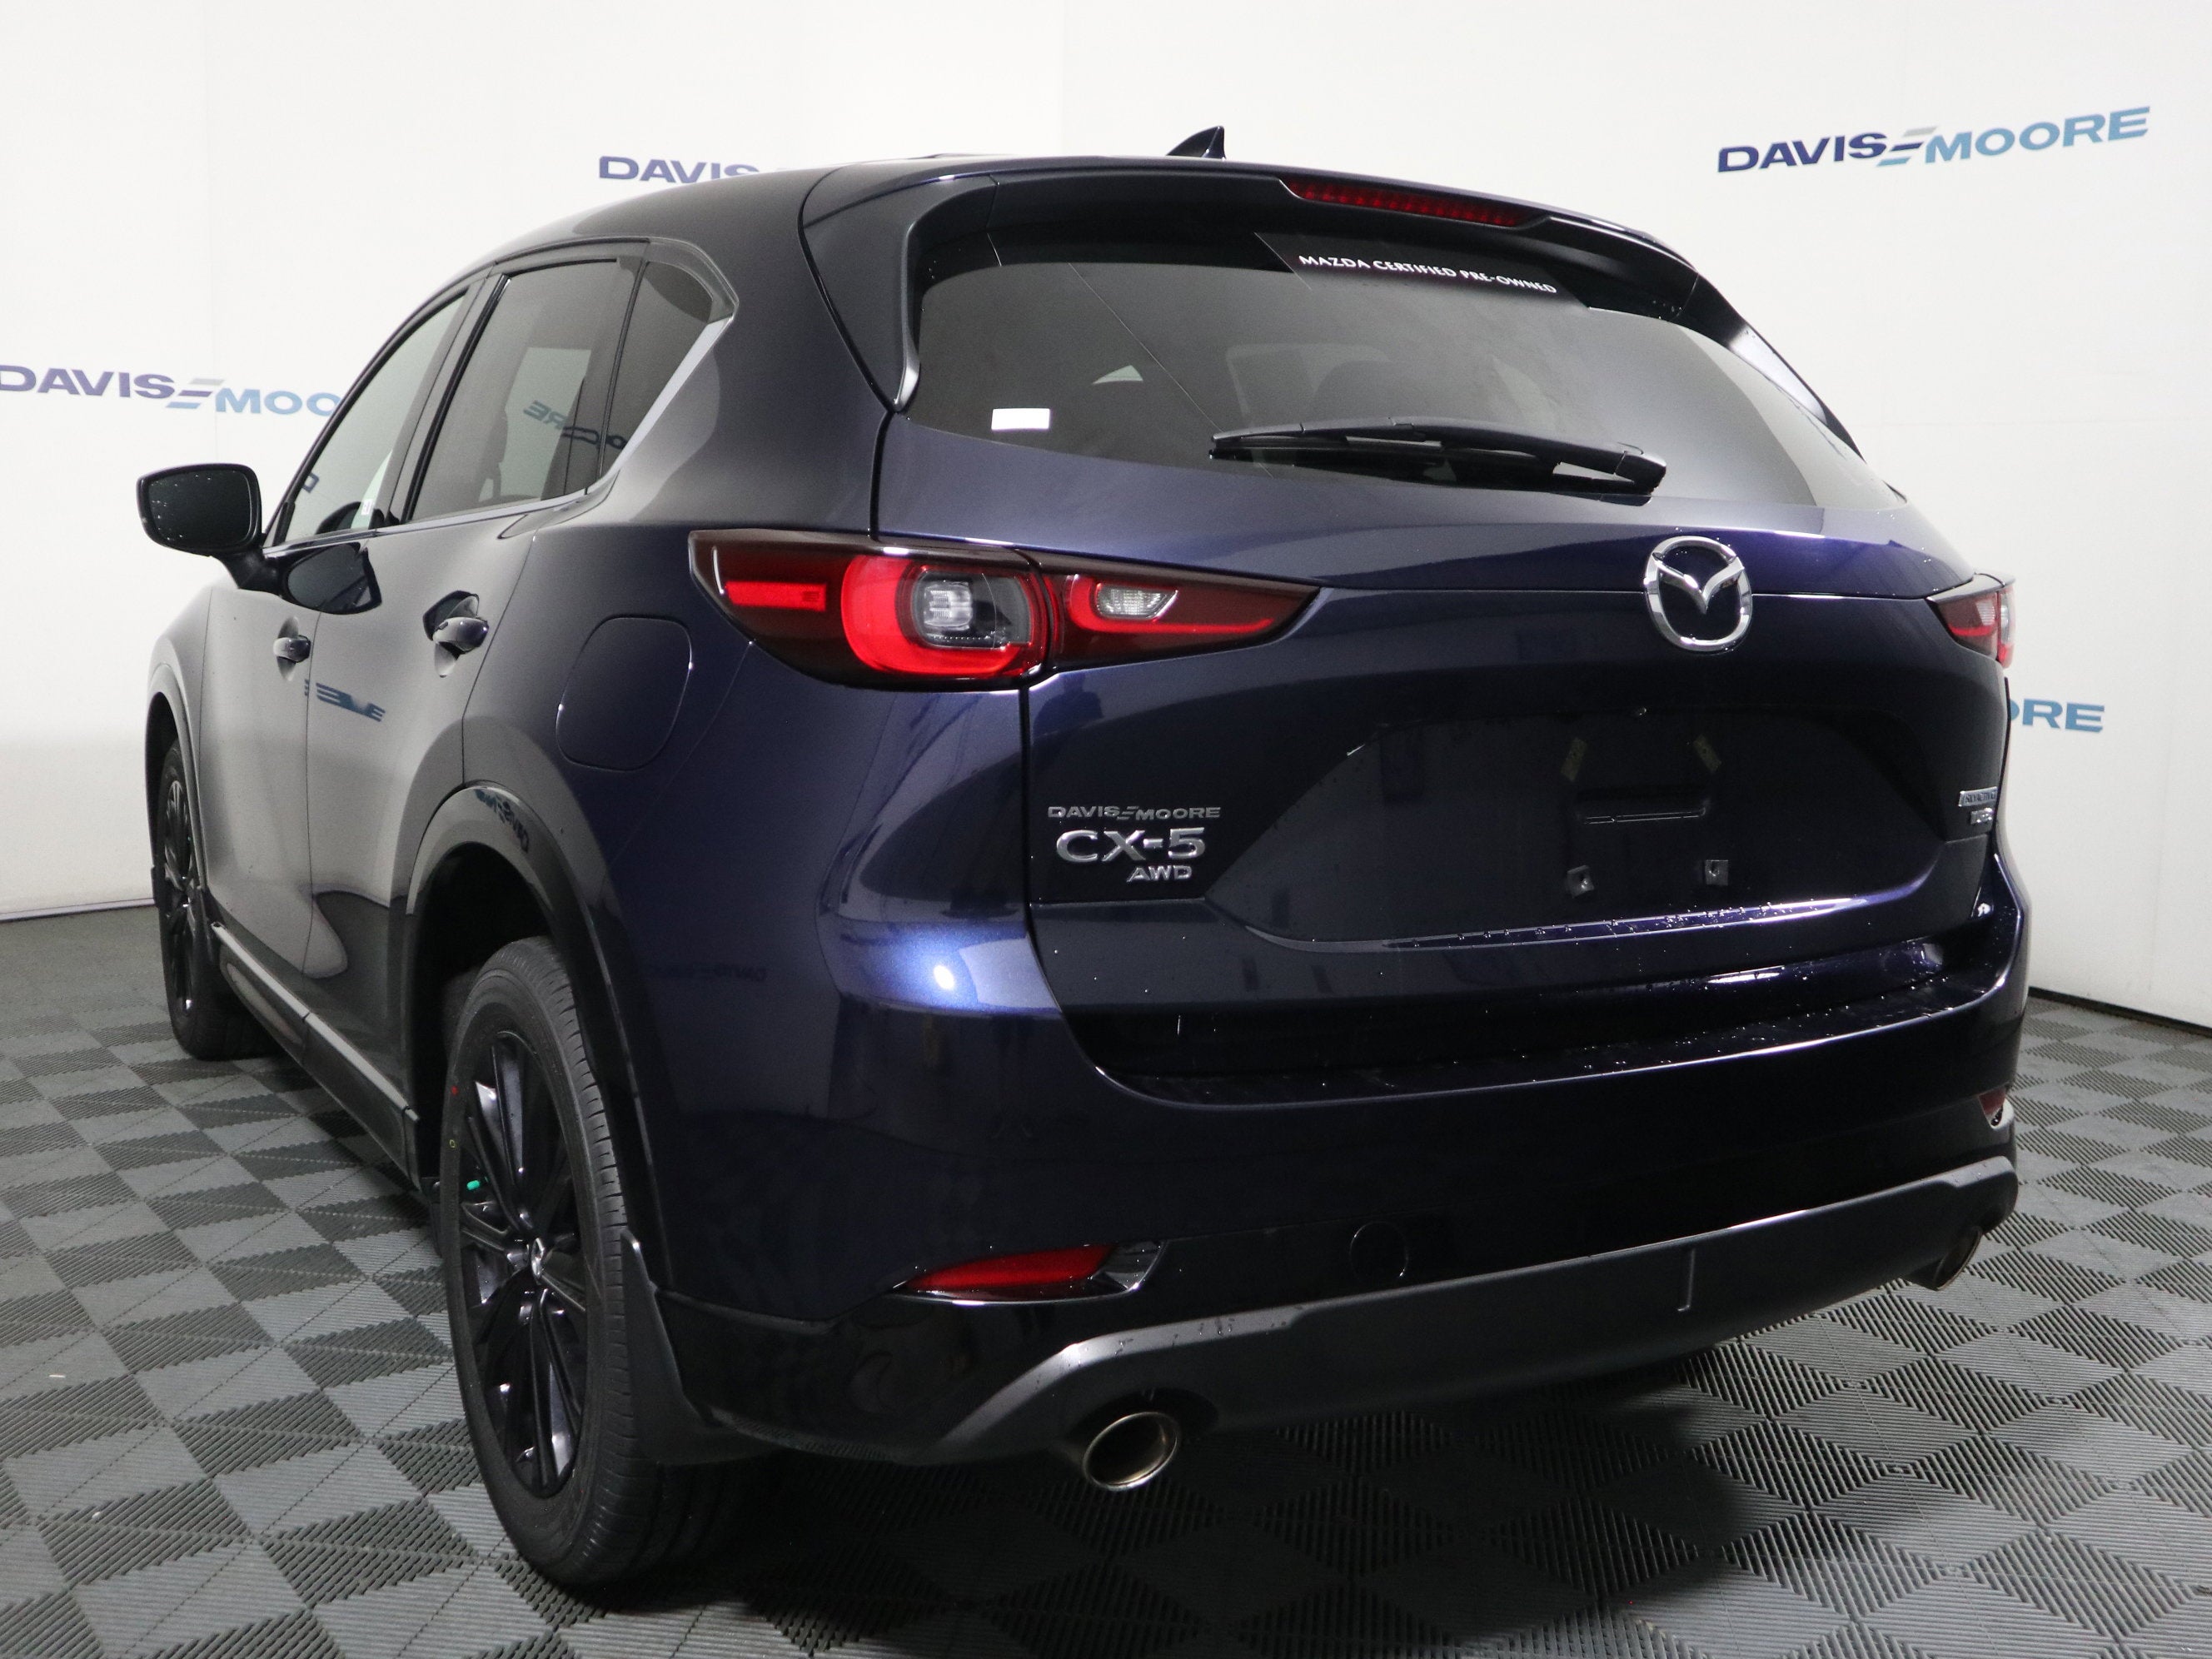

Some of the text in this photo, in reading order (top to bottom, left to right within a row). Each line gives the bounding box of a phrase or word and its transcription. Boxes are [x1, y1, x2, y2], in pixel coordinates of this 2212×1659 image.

[1717, 106, 2151, 172] DAVIS MOORE
[1298, 255, 1557, 294] MAZDA CERTIFIED PRE-OWNED
[0, 365, 176, 400] DAVIS
[1048, 805, 1222, 821] DAVIS MOORE
[1056, 827, 1206, 863] CX-5
[1126, 864, 1193, 883] AWD
